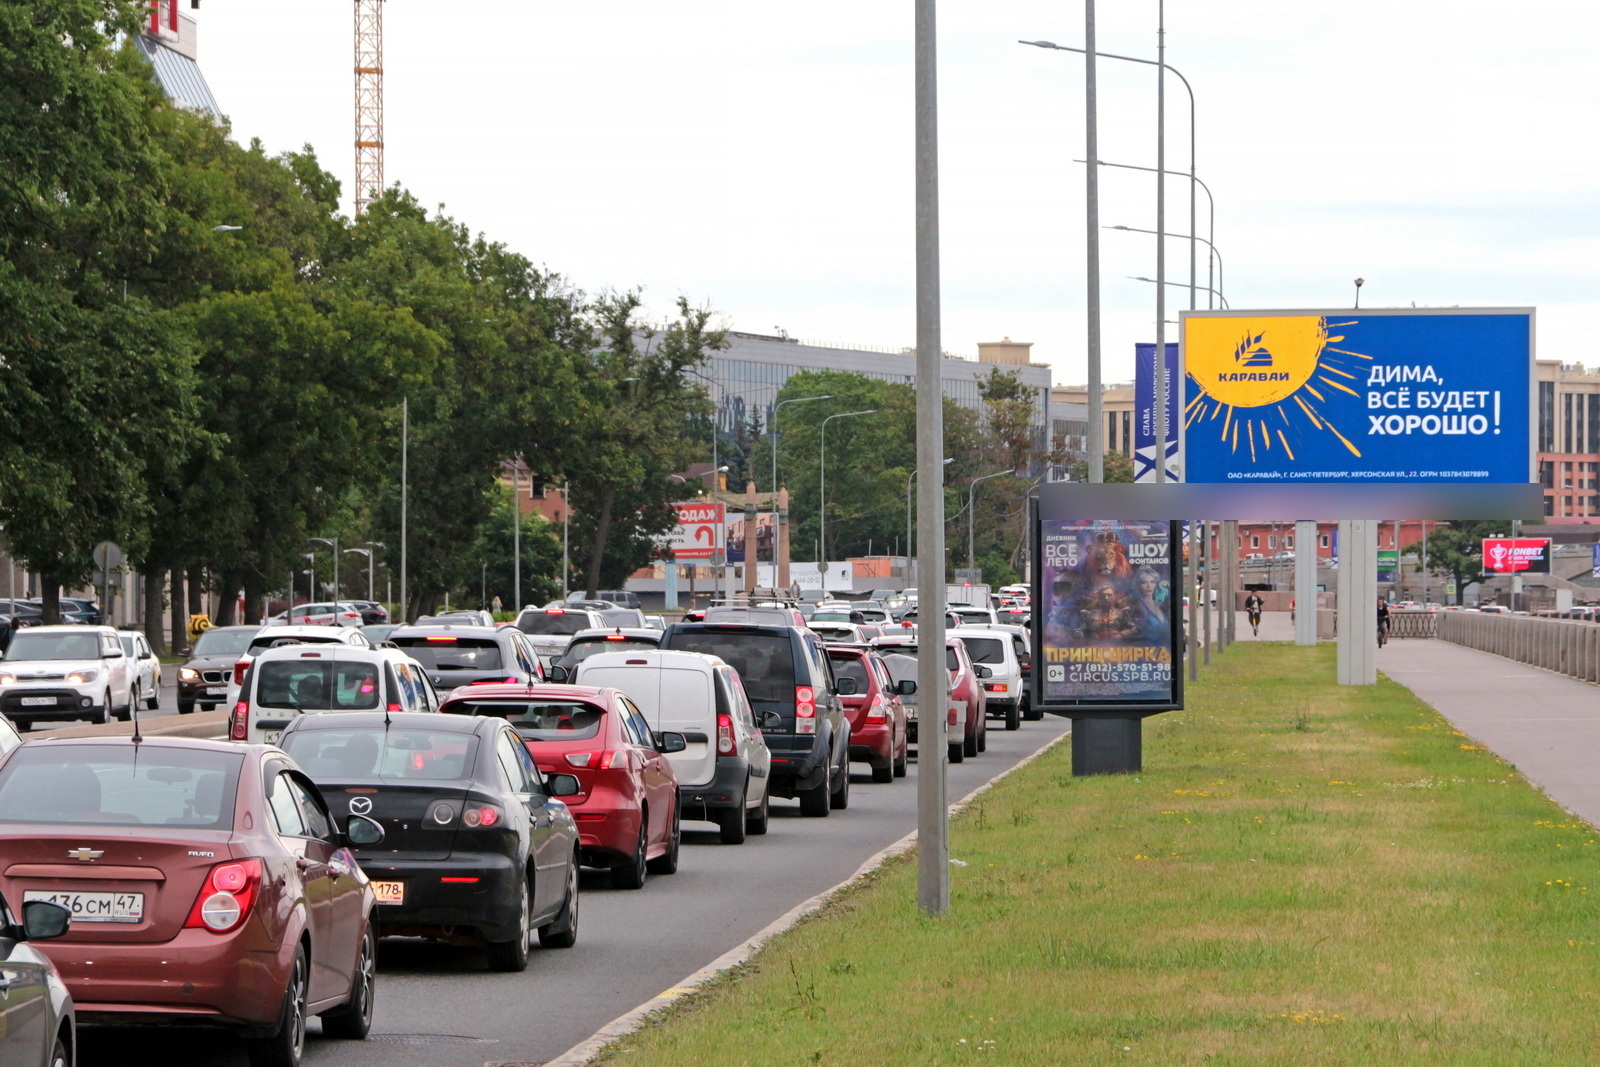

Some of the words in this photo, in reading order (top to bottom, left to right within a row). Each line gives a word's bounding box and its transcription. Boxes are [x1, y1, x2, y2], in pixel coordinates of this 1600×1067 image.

[1218, 371, 1289, 382] КАРАВАЙ
[1367, 365, 1443, 387] ДИМА,
[1368, 387, 1411, 409] ВСЁ
[1417, 391, 1490, 412] БУДЕТ
[1290, 471, 1350, 479] САНКТ-ПЕТЕРБУРГ,
[1129, 543, 1169, 557] ШОУ
[1046, 557, 1078, 567] ЛЕТО
[1049, 669, 1063, 677] 0+
[1086, 663, 1171, 673] (812)-570-51-98
[1069, 672, 1171, 681] CIRCUS.SPB.RU
[378, 884, 399, 895] 178
[117, 895, 136, 910] 47
